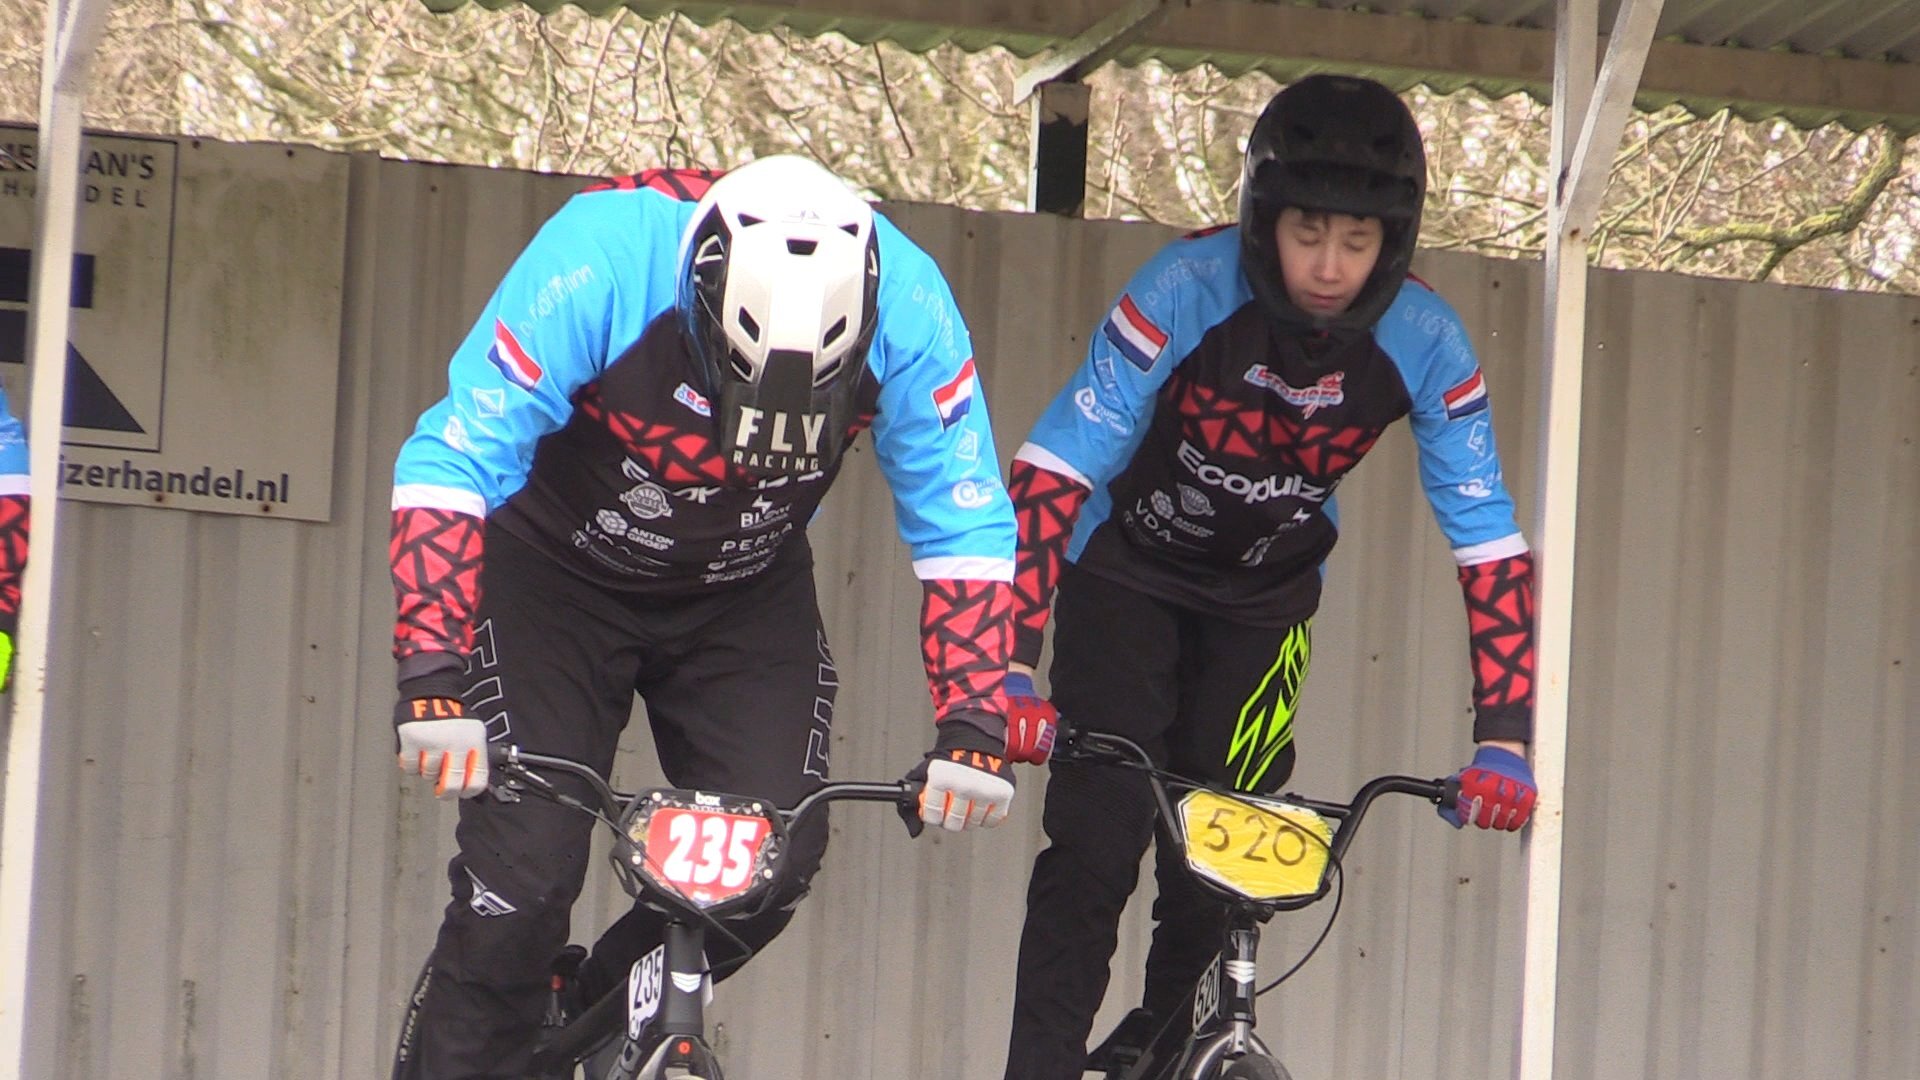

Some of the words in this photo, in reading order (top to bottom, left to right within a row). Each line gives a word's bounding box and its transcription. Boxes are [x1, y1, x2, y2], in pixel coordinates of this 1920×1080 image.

[735, 405, 827, 455] FLY
[732, 450, 819, 471] RACING
[628, 527, 675, 546] ANTON
[412, 698, 464, 719] FLY
[951, 749, 1003, 774] FLY
[663, 813, 758, 888] 235
[1203, 807, 1307, 866] 520
[632, 949, 663, 1010] 235
[1195, 959, 1219, 1027] 520
